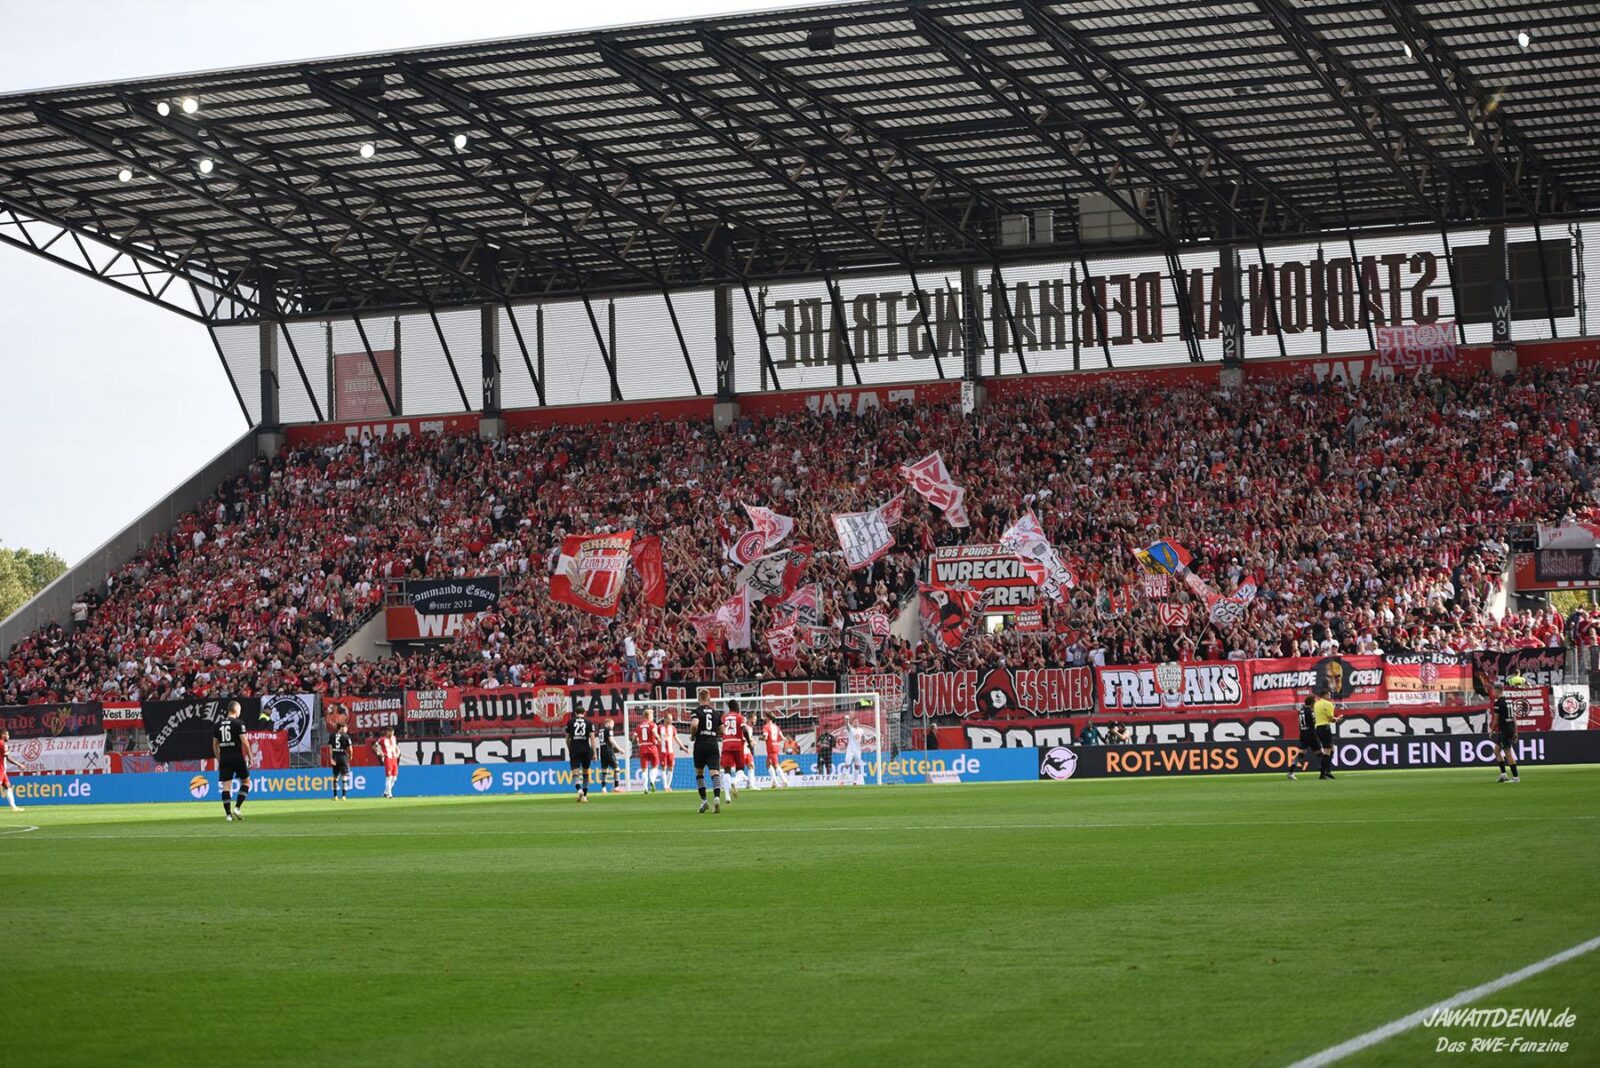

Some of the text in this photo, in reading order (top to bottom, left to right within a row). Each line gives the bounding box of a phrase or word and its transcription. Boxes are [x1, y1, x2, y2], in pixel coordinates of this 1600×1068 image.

[1494, 305, 1508, 319] W
[1223, 324, 1235, 336] W
[1495, 321, 1507, 335] 3
[1225, 339, 1234, 353] 2
[1380, 344, 1456, 366] KASTEN
[465, 584, 496, 600] Essen
[453, 600, 473, 609] 2012
[1253, 669, 1383, 691] NORTHSIDE CREW
[913, 669, 978, 718] JUNGE
[1015, 667, 1094, 713] ESSENER
[462, 688, 651, 722] RUDE FANS
[356, 713, 399, 728] ESSEN
[705, 714, 713, 731] 6
[724, 720, 737, 736] 29
[219, 724, 231, 742] 16
[574, 721, 586, 737] 23
[334, 734, 342, 749] 5
[1106, 748, 1239, 773] ROT-WEISS
[1408, 742, 1451, 764] EIN
[1460, 739, 1545, 763] BOH!
